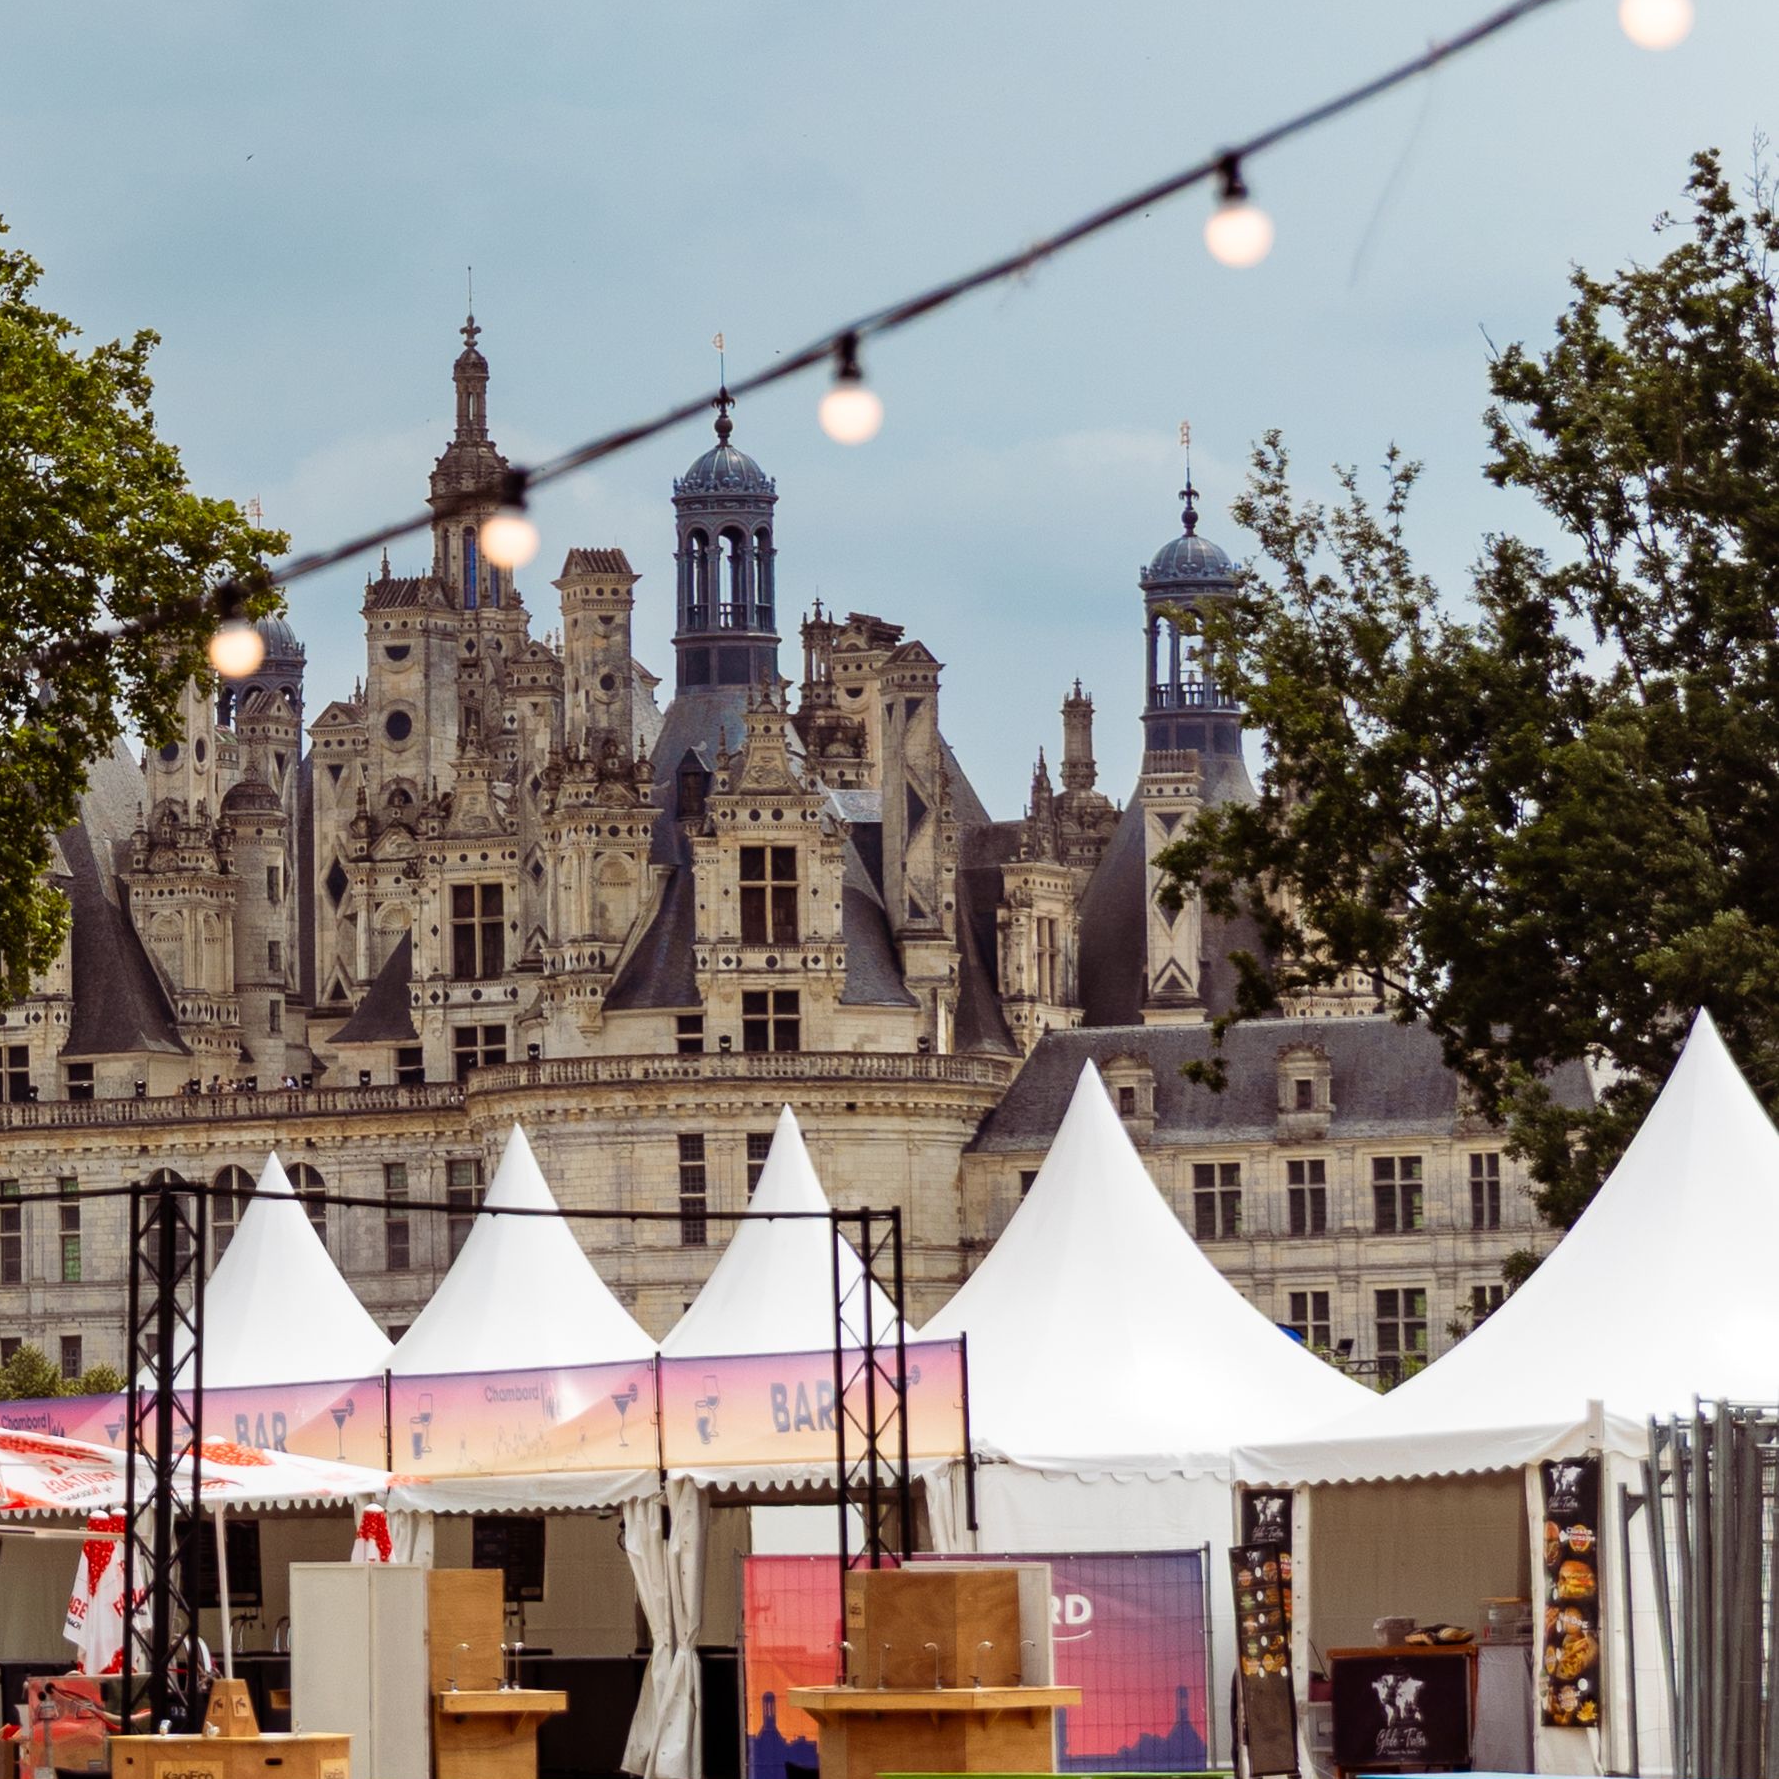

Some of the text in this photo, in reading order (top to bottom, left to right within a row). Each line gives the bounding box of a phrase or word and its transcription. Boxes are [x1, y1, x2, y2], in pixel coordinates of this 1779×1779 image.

[484, 1385, 540, 1403] Chambord
[772, 1380, 837, 1433] BAR
[234, 1411, 289, 1453] BAR
